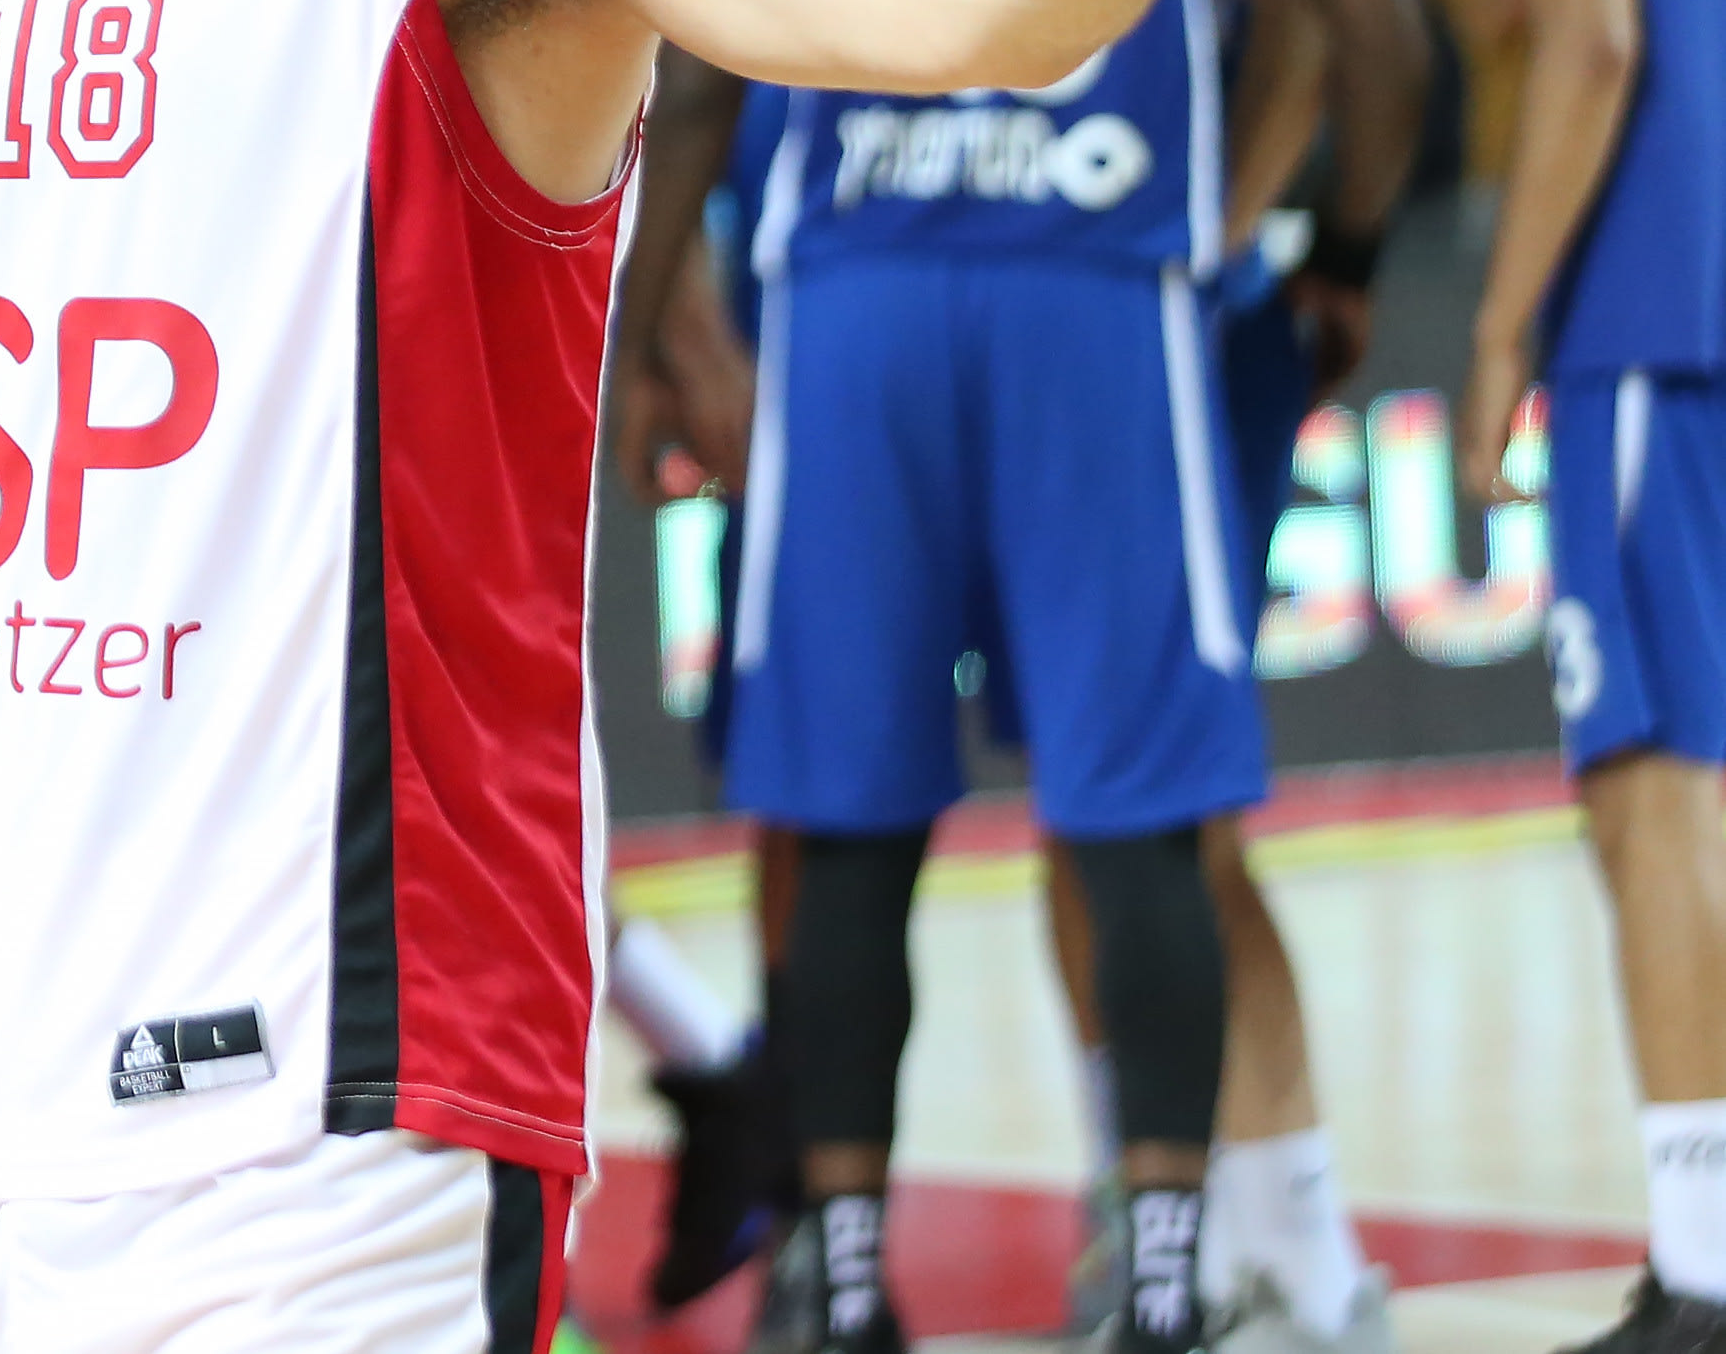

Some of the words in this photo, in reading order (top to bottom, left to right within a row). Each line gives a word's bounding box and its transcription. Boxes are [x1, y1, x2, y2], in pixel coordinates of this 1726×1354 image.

[212, 1026, 226, 1046] L
[122, 1043, 166, 1070] PEAK
[119, 1070, 171, 1086] BASKETBALL
